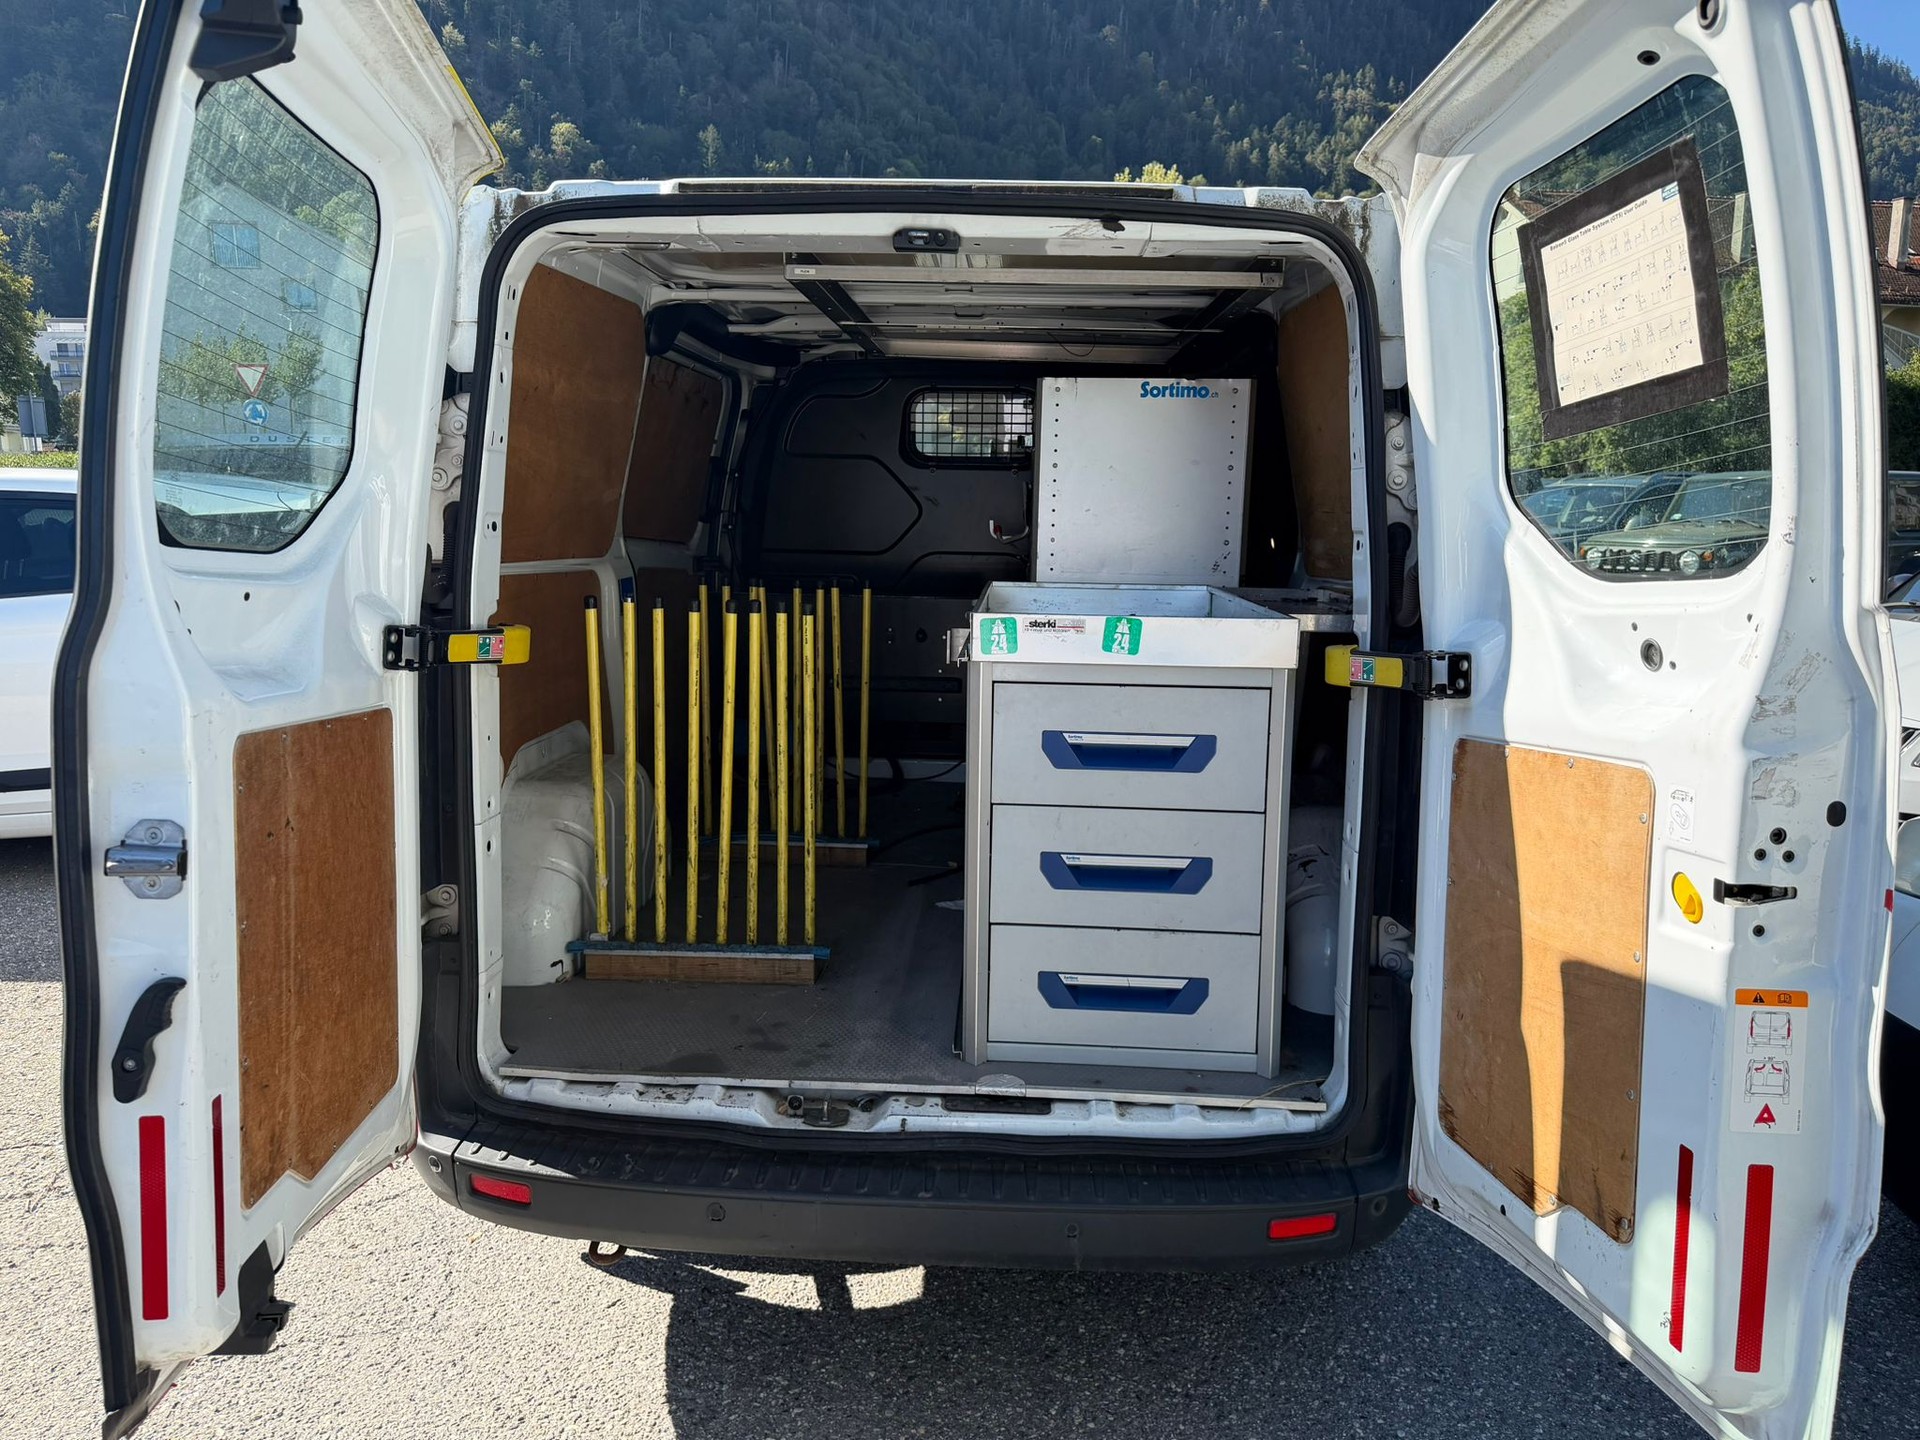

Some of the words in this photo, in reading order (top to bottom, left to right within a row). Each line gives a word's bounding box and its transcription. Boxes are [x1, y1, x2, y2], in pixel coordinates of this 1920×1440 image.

[1592, 219, 1609, 231] System
[1029, 619, 1056, 628] sterki
[990, 634, 1008, 651] 24
[1111, 632, 1130, 650] 24
